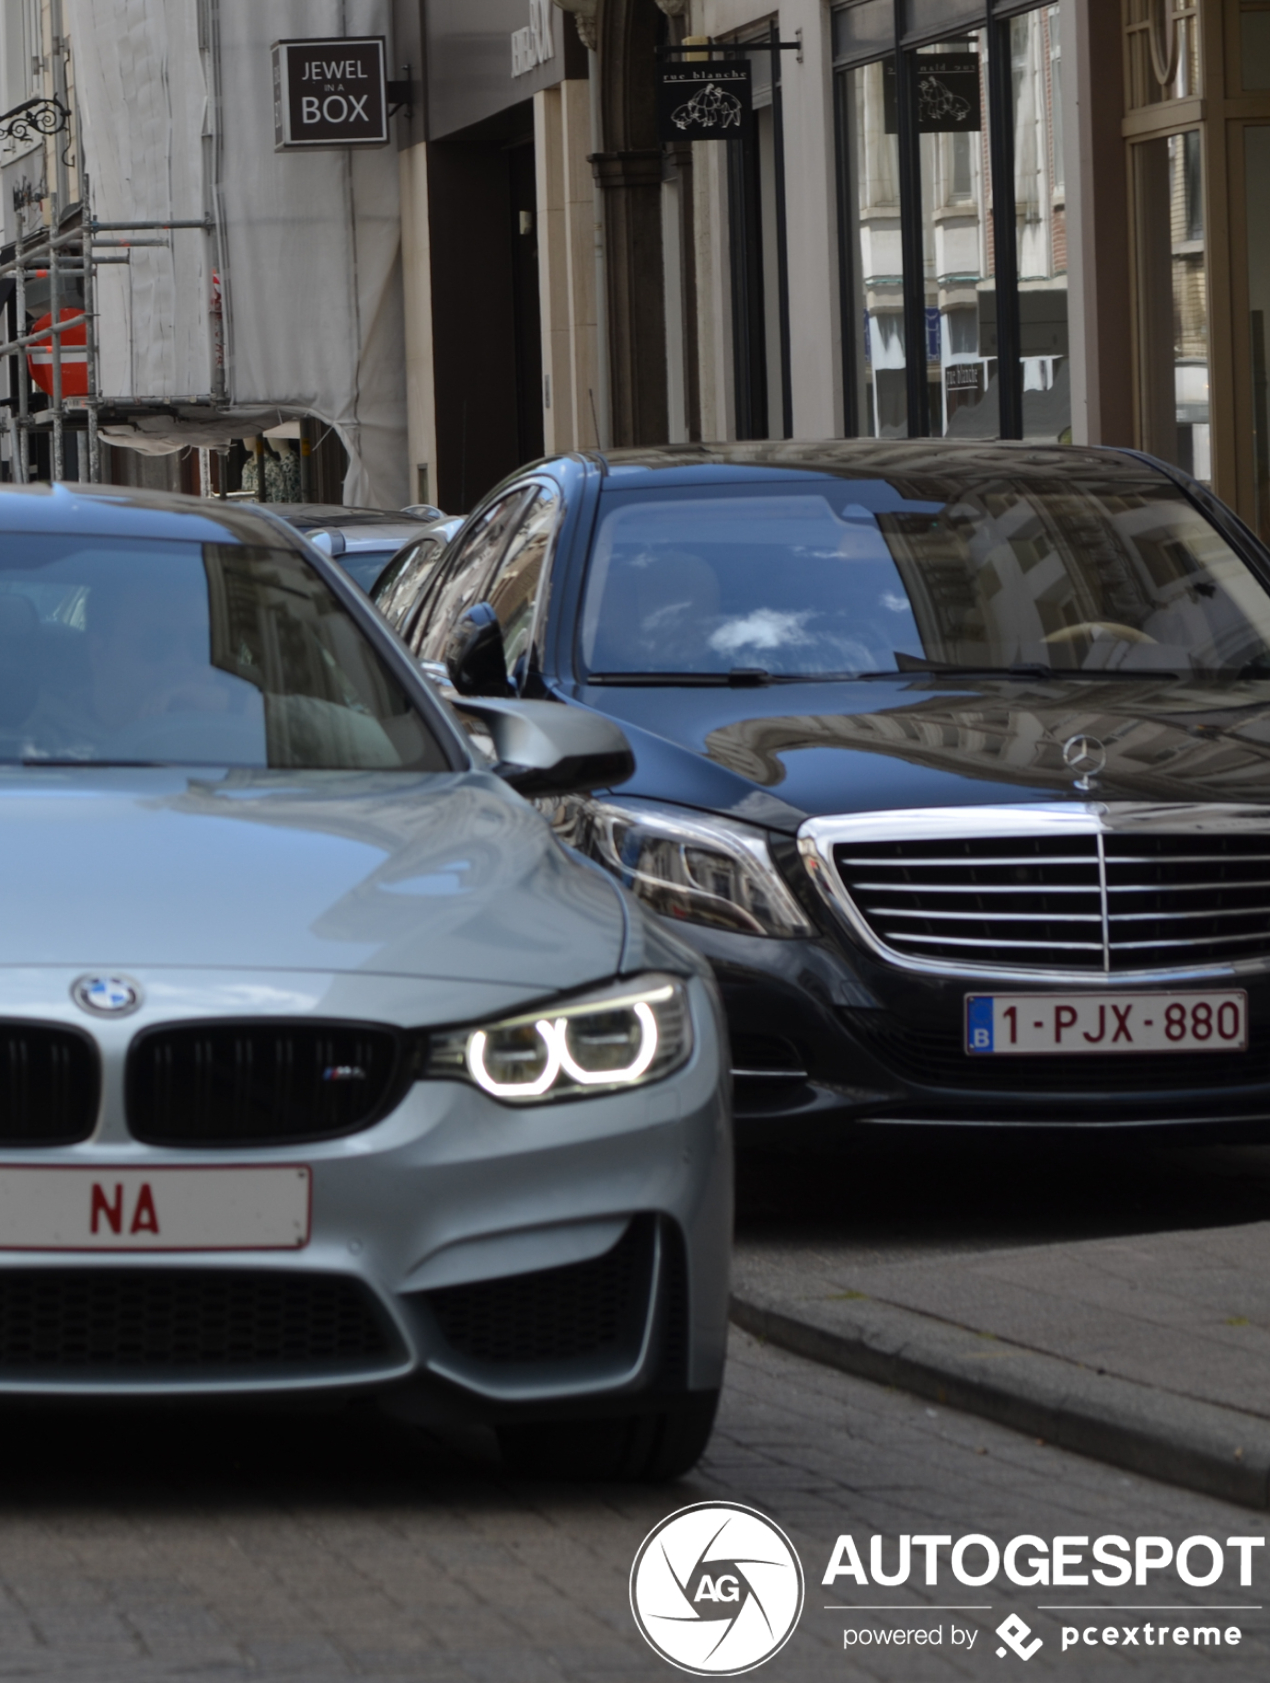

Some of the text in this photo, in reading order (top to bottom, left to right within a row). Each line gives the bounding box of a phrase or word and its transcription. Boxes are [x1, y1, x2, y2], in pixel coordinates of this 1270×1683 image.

[302, 60, 368, 80] JEWEL
[693, 70, 747, 79] blanche
[324, 84, 345, 92] IN A
[302, 94, 369, 123] BOX
[974, 1002, 1239, 1048] B 1-PJX-880
[91, 1183, 160, 1235] NA
